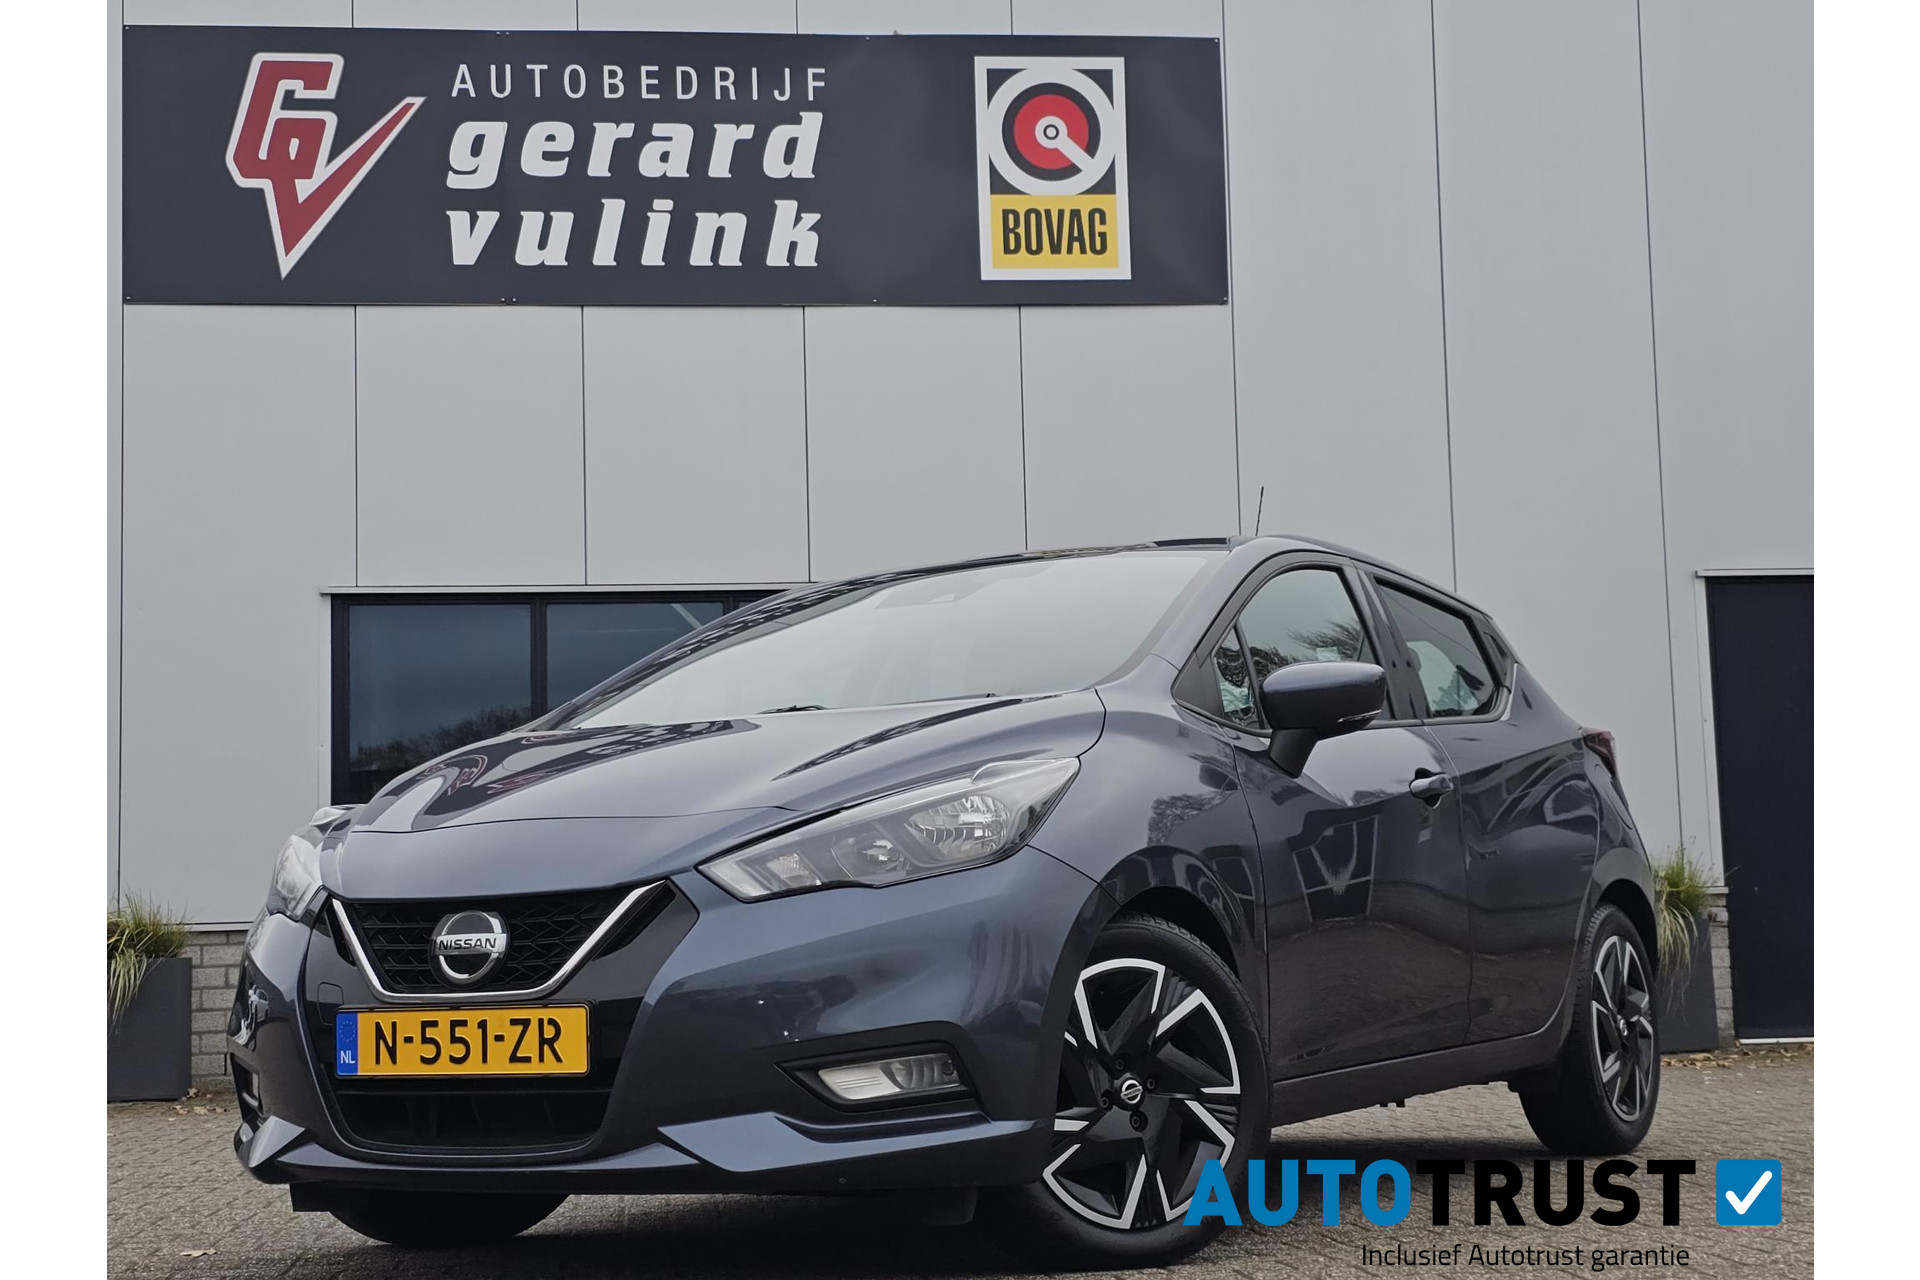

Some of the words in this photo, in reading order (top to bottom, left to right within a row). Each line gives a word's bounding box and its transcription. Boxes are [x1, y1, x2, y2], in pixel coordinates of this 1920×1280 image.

[452, 64, 826, 102] AUTOBEDRIJF
[446, 111, 824, 190] gerard
[446, 199, 822, 267] vulink
[1002, 207, 1108, 256] BOVAG
[438, 936, 497, 951] NISSAN
[340, 1050, 356, 1064] NL
[374, 1017, 564, 1066] N-551-ZR
